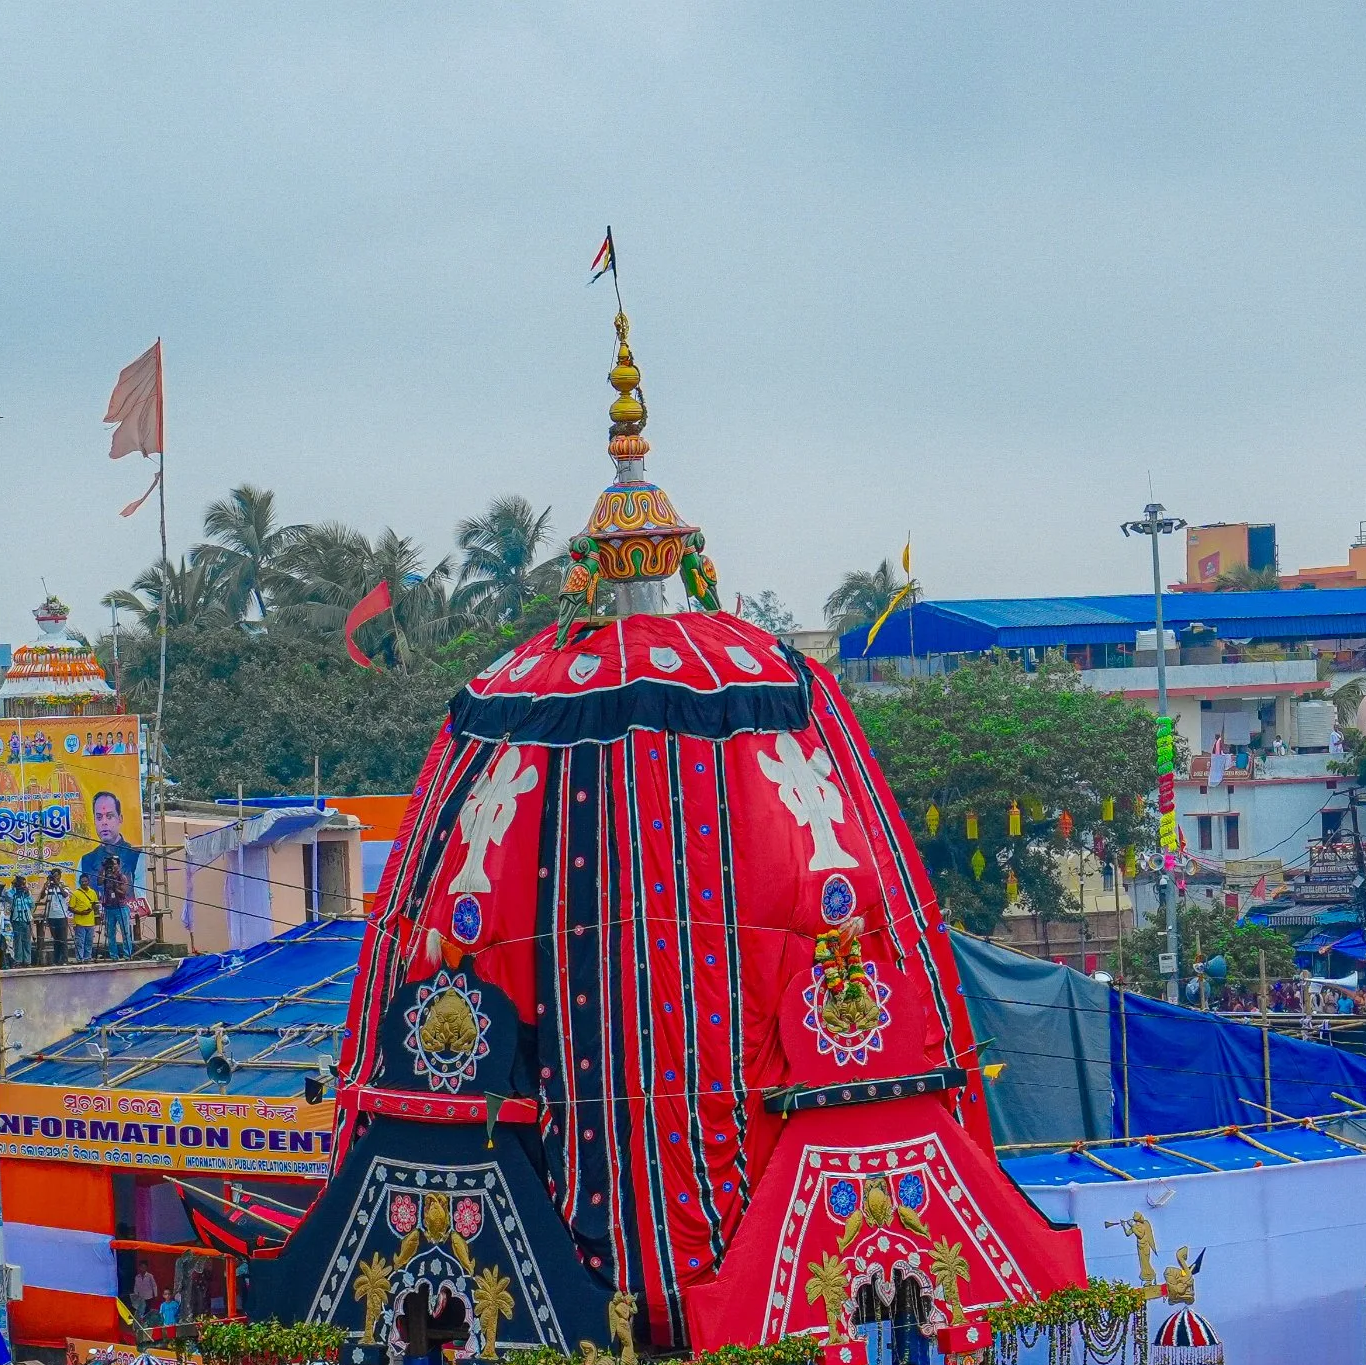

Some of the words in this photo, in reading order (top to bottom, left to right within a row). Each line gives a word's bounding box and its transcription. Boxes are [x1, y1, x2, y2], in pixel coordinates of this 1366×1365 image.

[63, 1094, 112, 1115] ସୂଚନା
[118, 1097, 161, 1118] କେନ୍ଦ୍ର
[192, 1101, 249, 1122] सूचना
[252, 1099, 298, 1123] केन्द्र
[240, 1128, 332, 1154] CENT
[135, 1153, 173, 1167] ସରକାର
[185, 1156, 226, 1169] INFORMATION
[234, 1159, 257, 1171] PUBLIC
[258, 1160, 292, 1173] RELATIONS
[293, 1161, 329, 1174] DEPARTMEN
